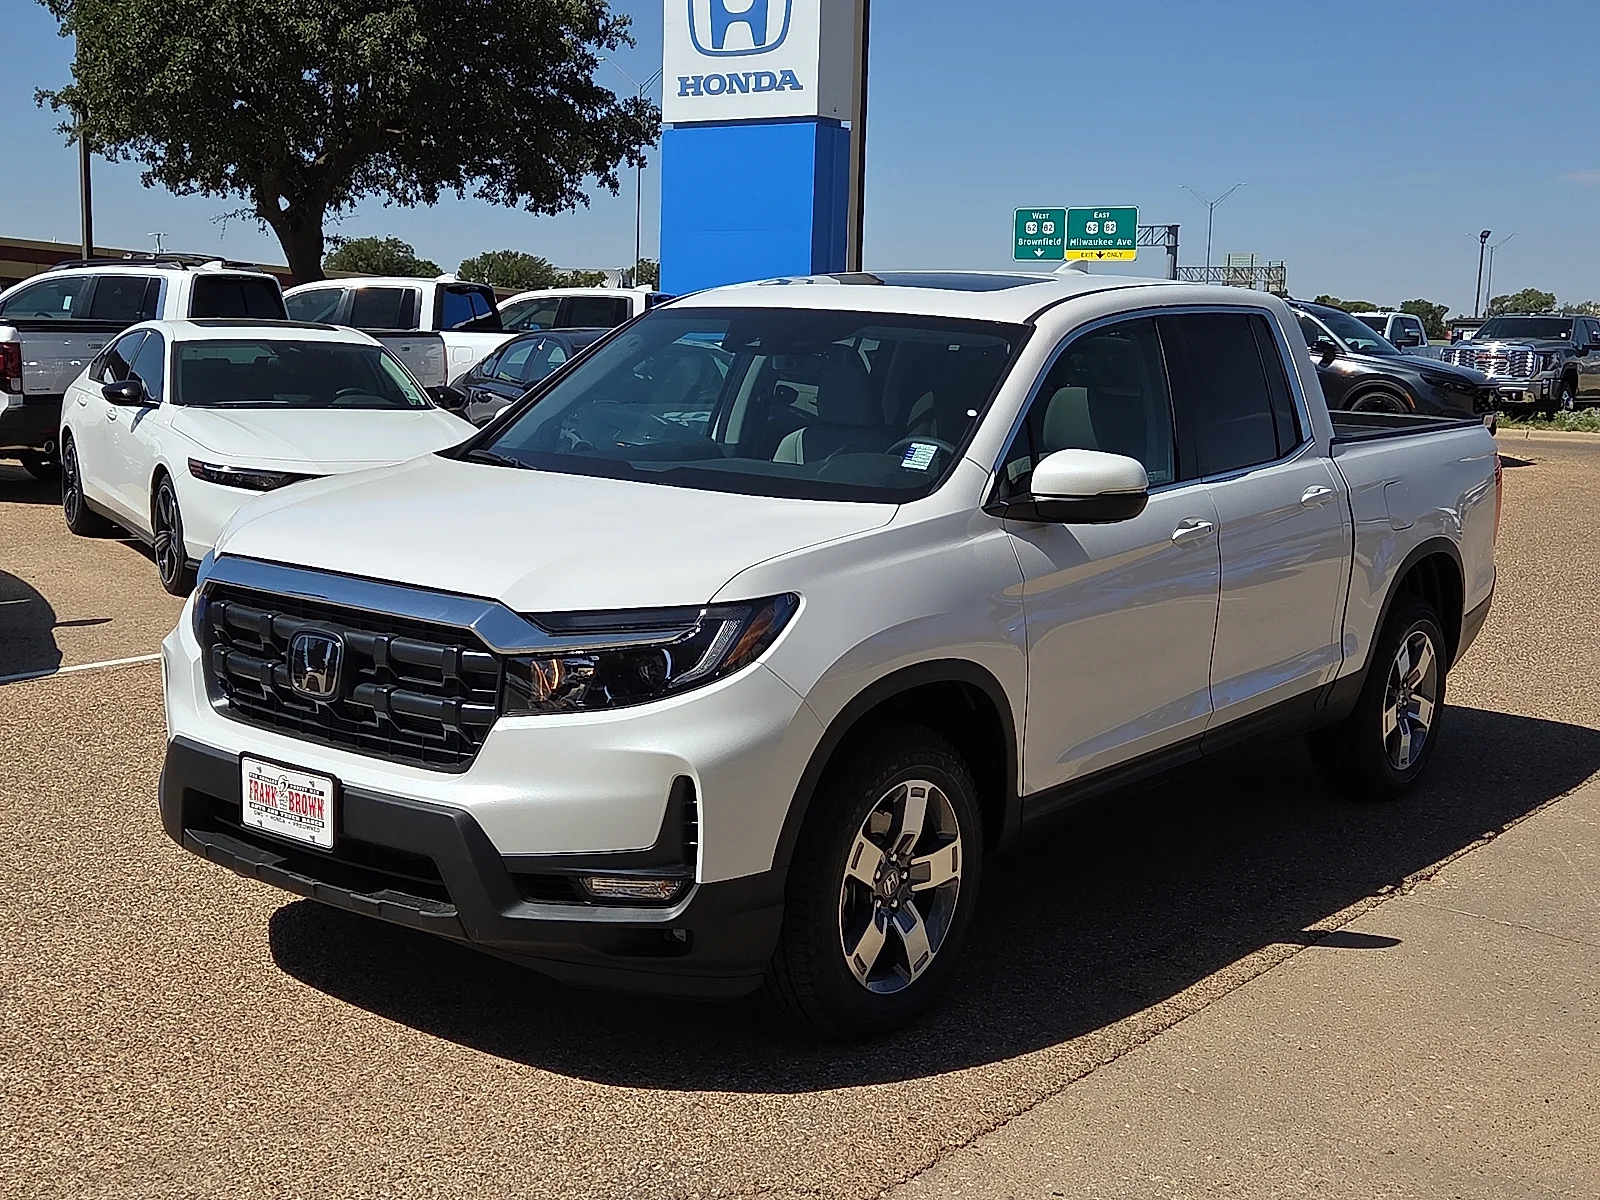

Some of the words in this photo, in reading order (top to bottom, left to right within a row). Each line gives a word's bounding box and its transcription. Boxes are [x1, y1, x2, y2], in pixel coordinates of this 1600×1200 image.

[677, 69, 804, 97] HONDA
[1018, 237, 1062, 246] Brownfield
[1070, 238, 1114, 246] Milwaukee
[1116, 238, 1133, 246] Ave
[249, 779, 278, 808] FRANK
[288, 790, 325, 820] BROWN
